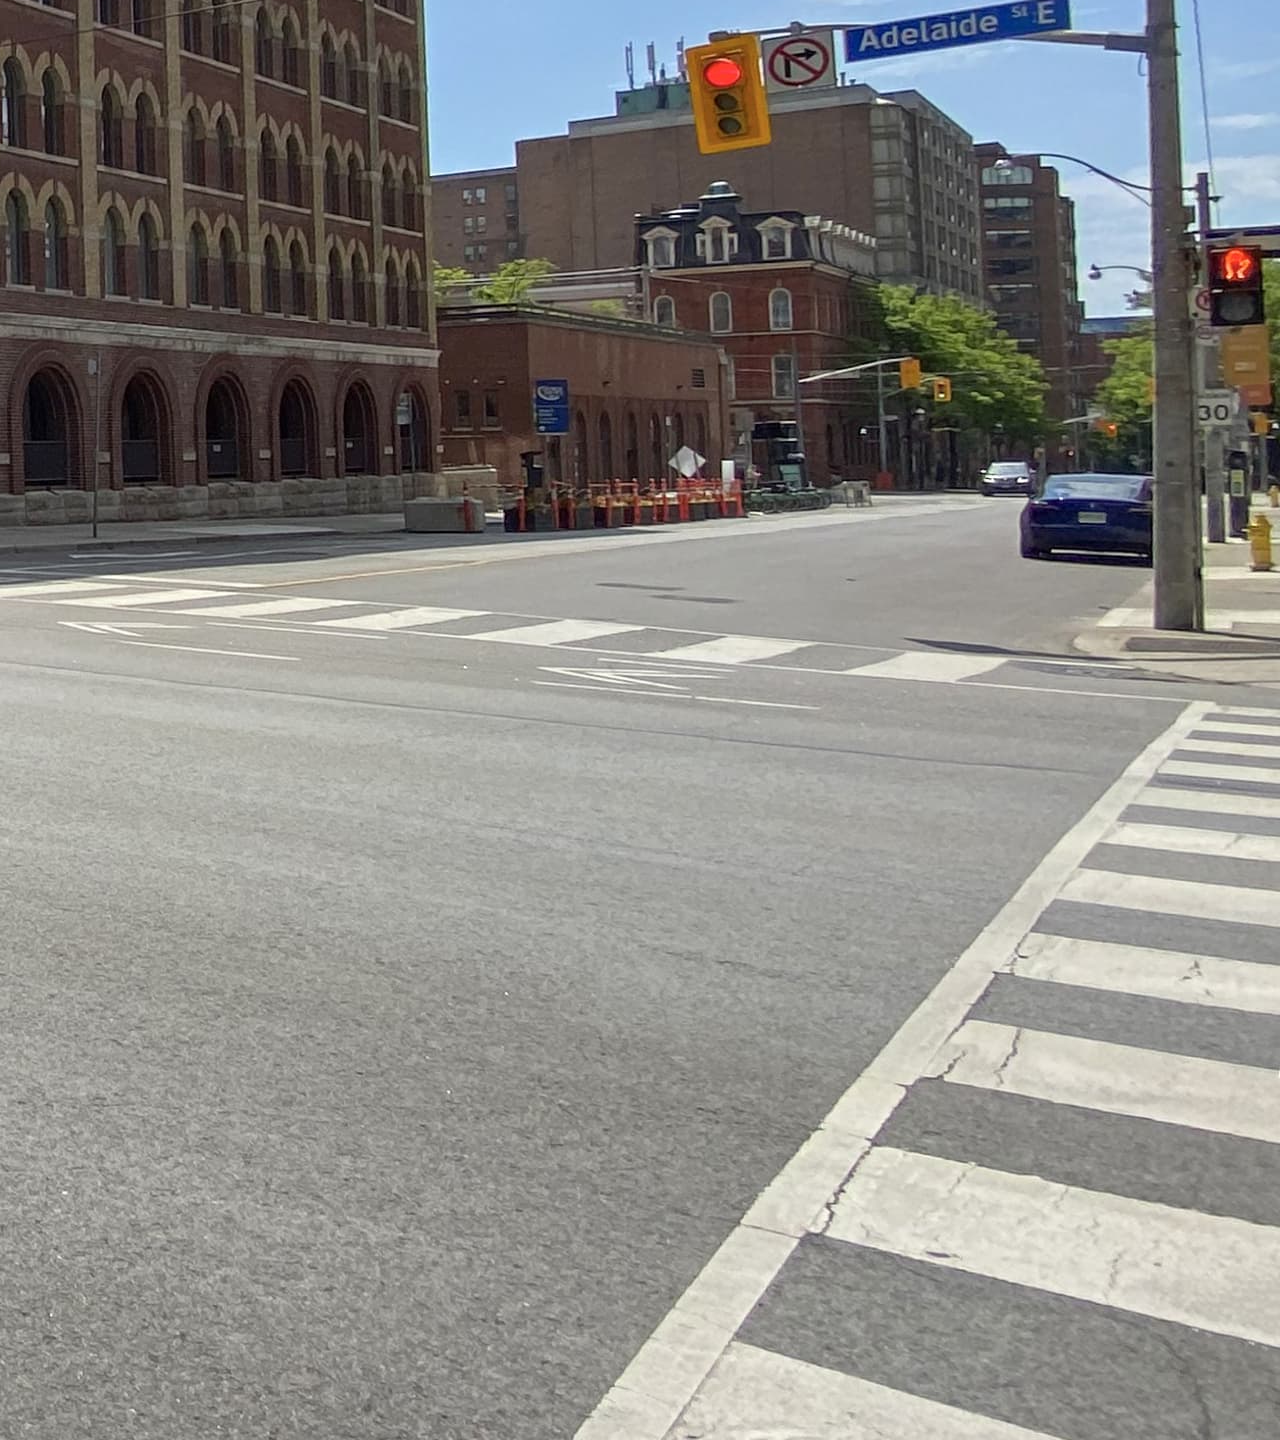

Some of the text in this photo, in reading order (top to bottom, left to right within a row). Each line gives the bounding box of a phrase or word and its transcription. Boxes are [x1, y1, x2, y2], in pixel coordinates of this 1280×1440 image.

[859, 0, 1056, 53] Adelaide St E
[1198, 405, 1229, 421] 30
